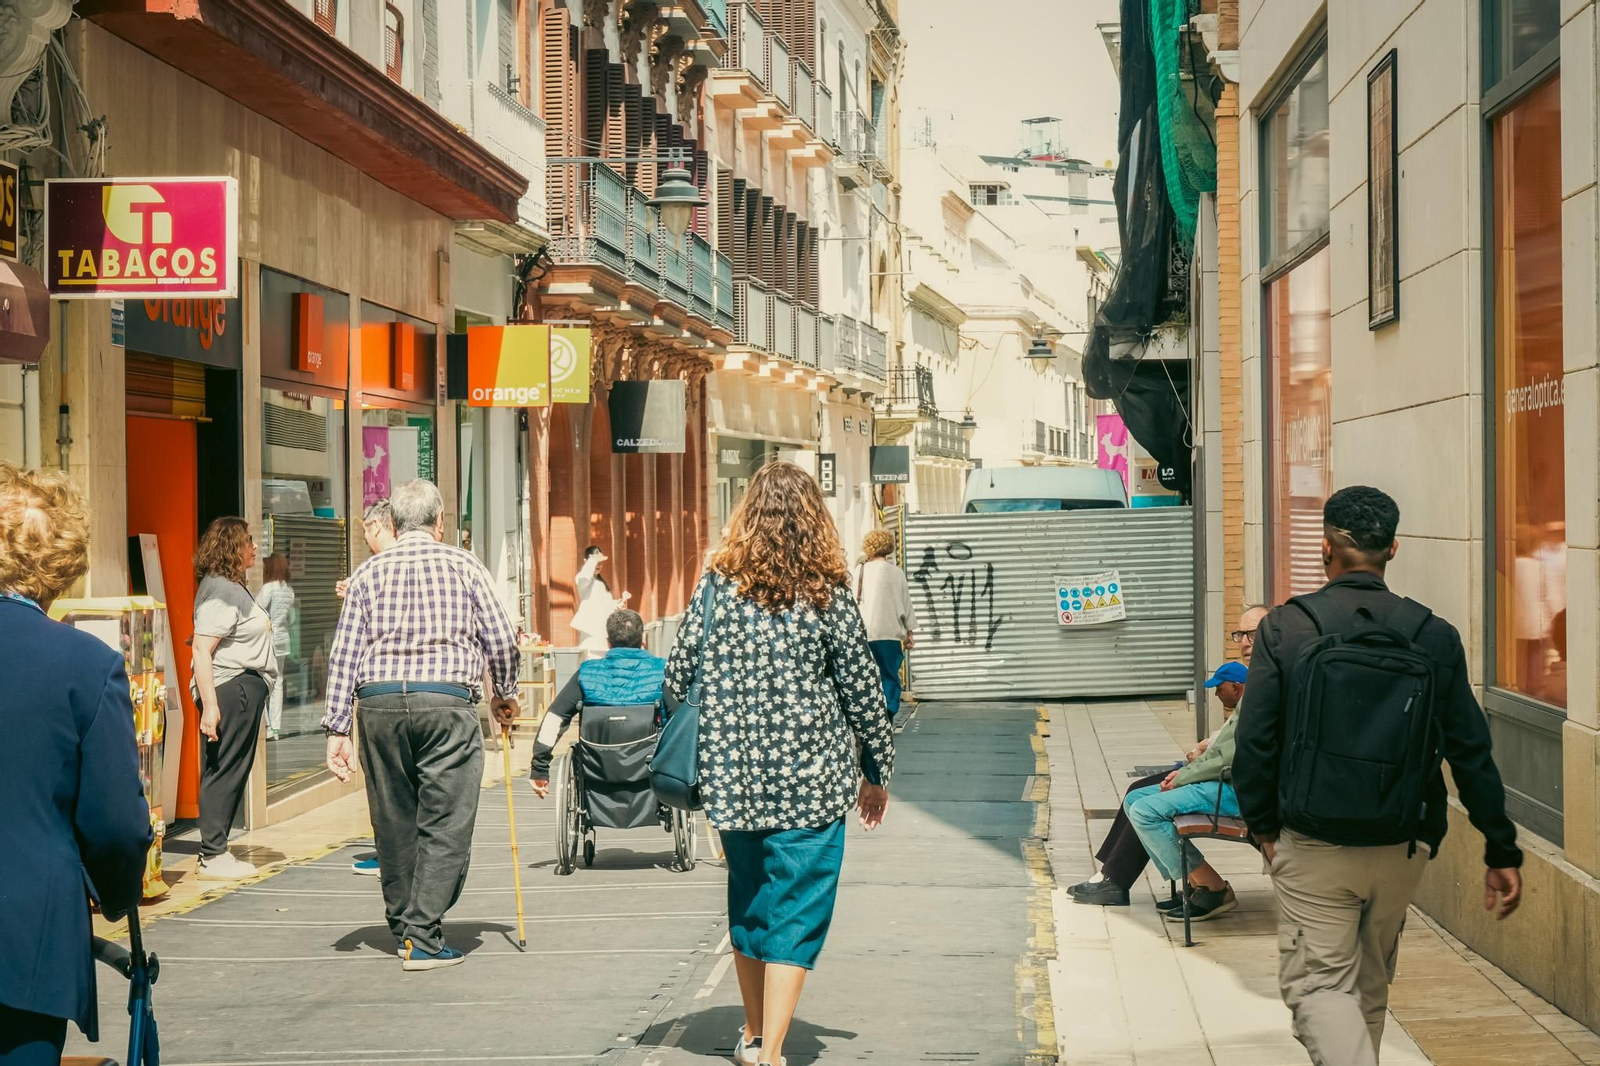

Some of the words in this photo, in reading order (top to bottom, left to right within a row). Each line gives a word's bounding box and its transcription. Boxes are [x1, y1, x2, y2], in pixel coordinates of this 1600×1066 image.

[58, 247, 217, 277] TABACOS
[472, 385, 540, 404] orange
[873, 473, 908, 481] TEZENIS
